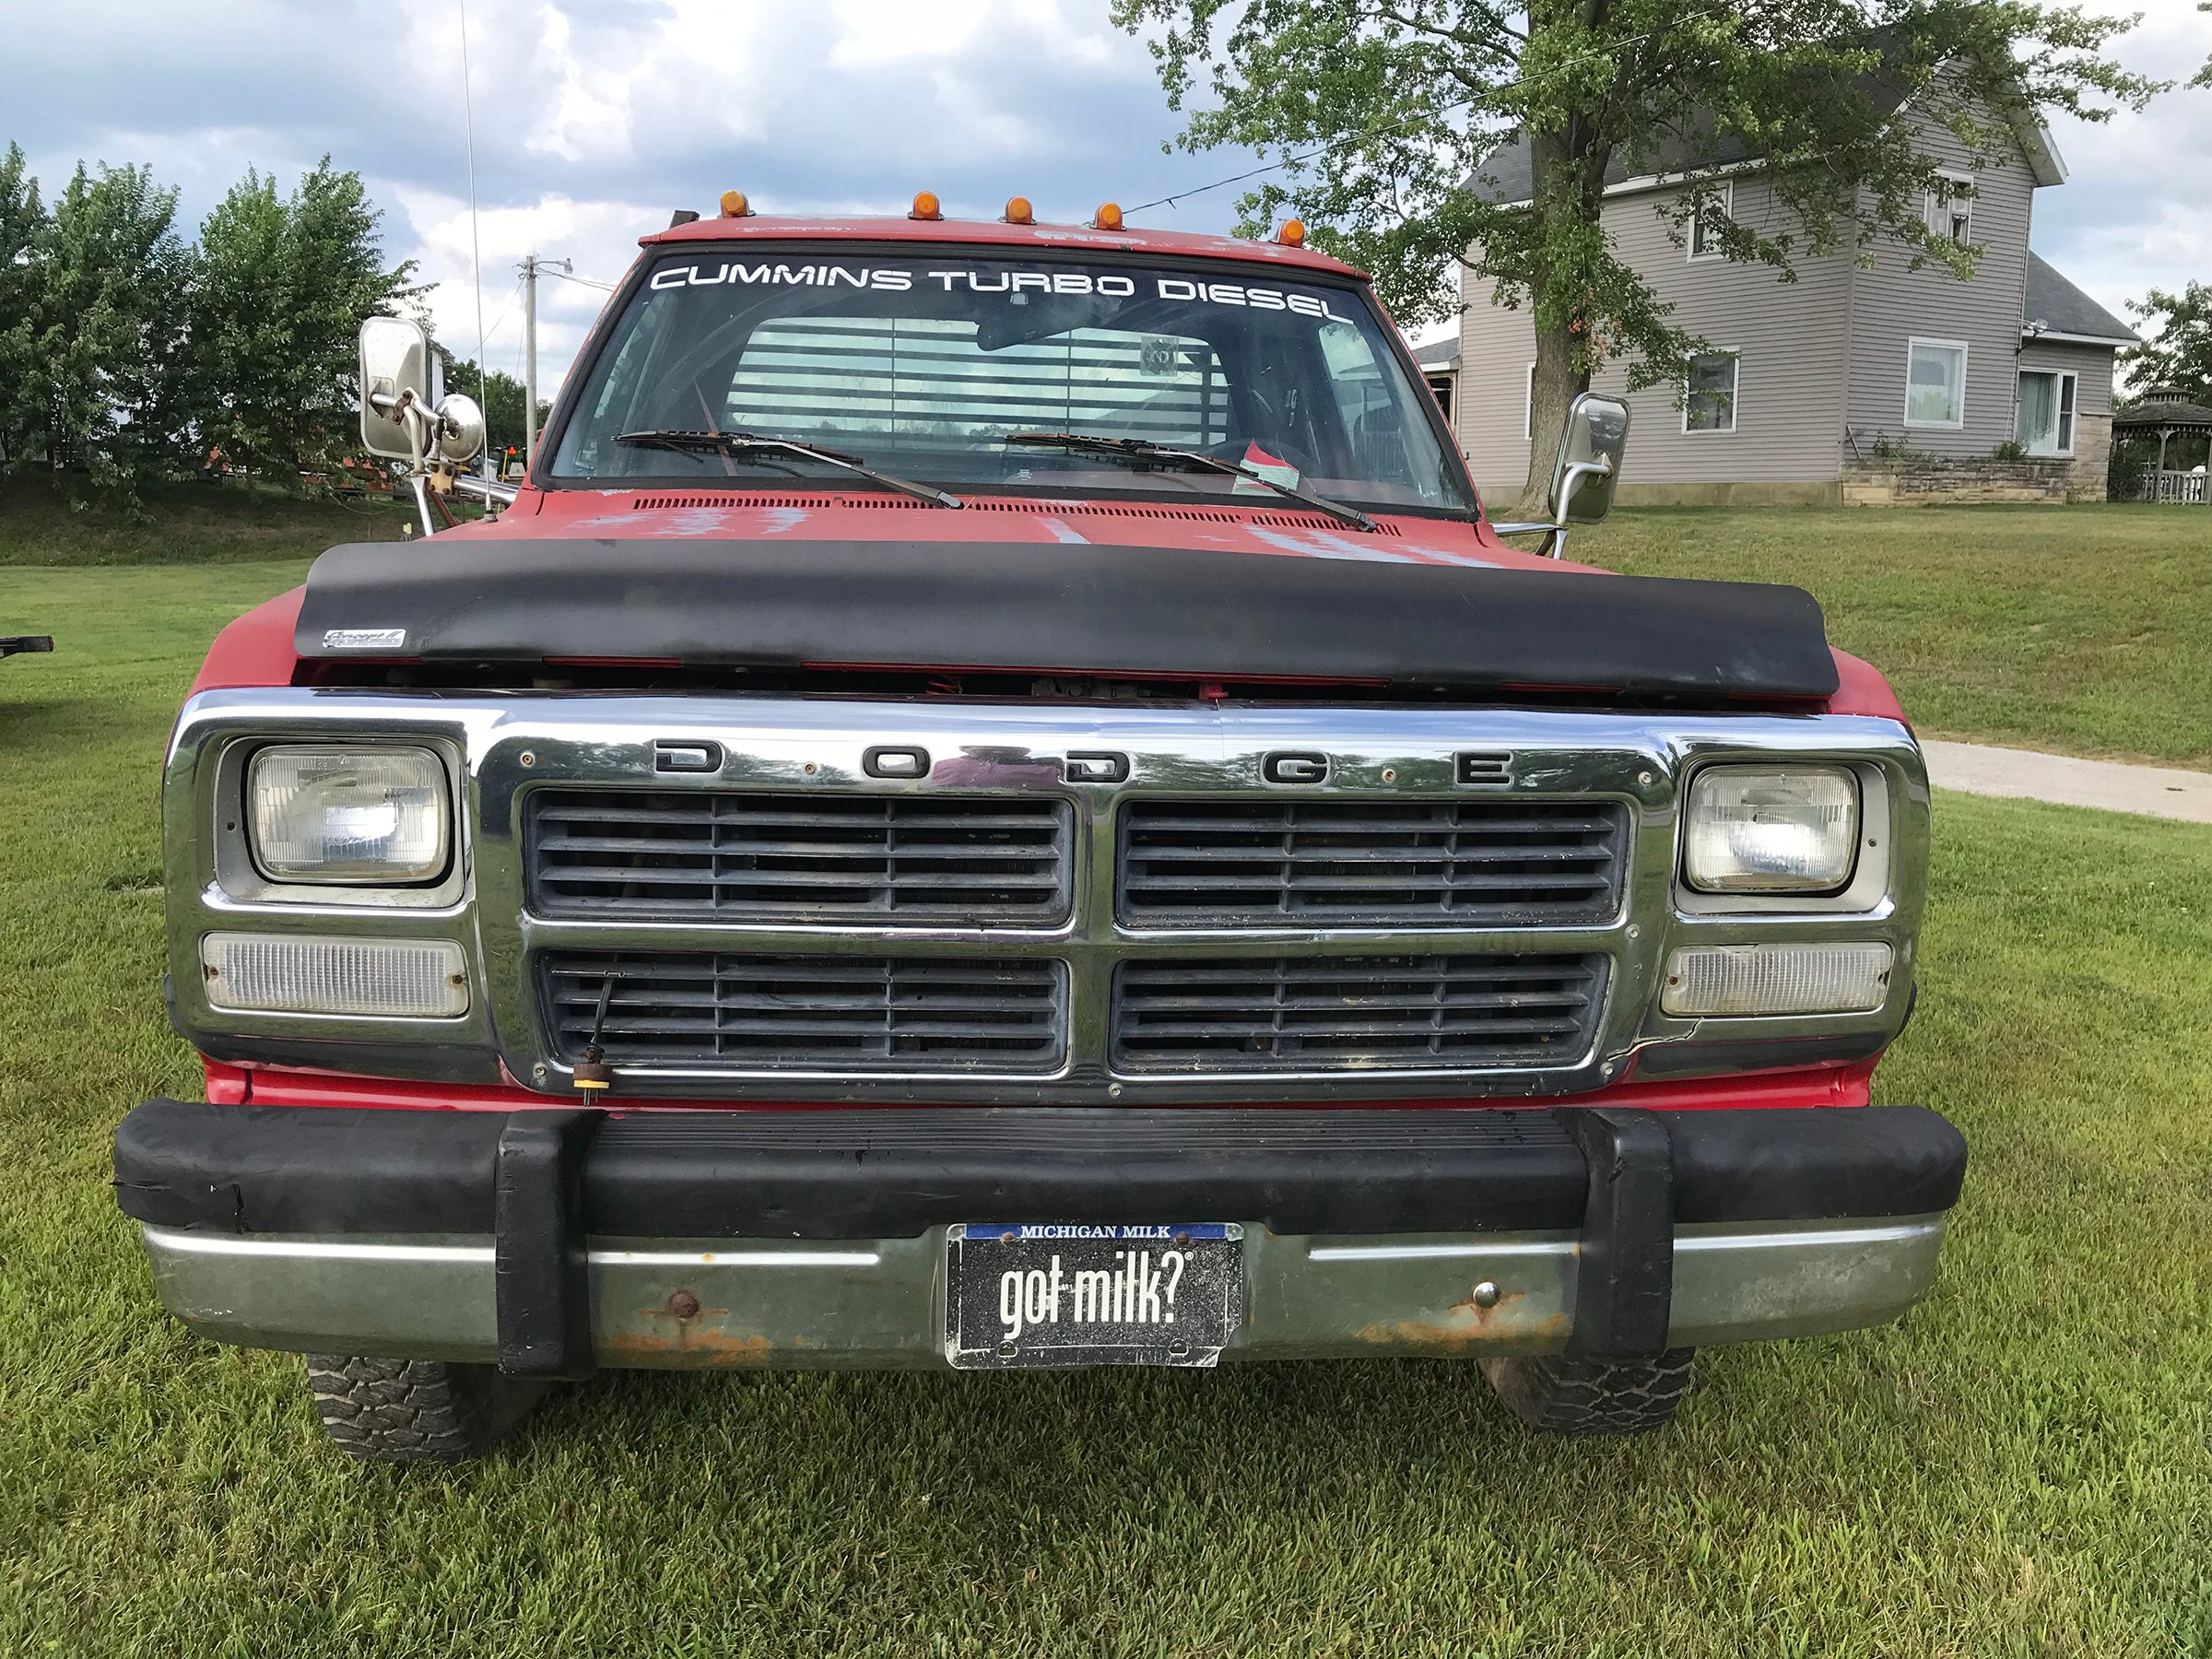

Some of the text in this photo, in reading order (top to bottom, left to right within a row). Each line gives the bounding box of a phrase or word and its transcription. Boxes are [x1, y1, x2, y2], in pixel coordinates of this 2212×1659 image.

[650, 264, 1354, 325] CUMMINS TURBO DIESEL
[653, 738, 1512, 786] DODGE
[1020, 1225, 1171, 1239] MICHIGAN MILK
[1000, 1254, 1064, 1341] got
